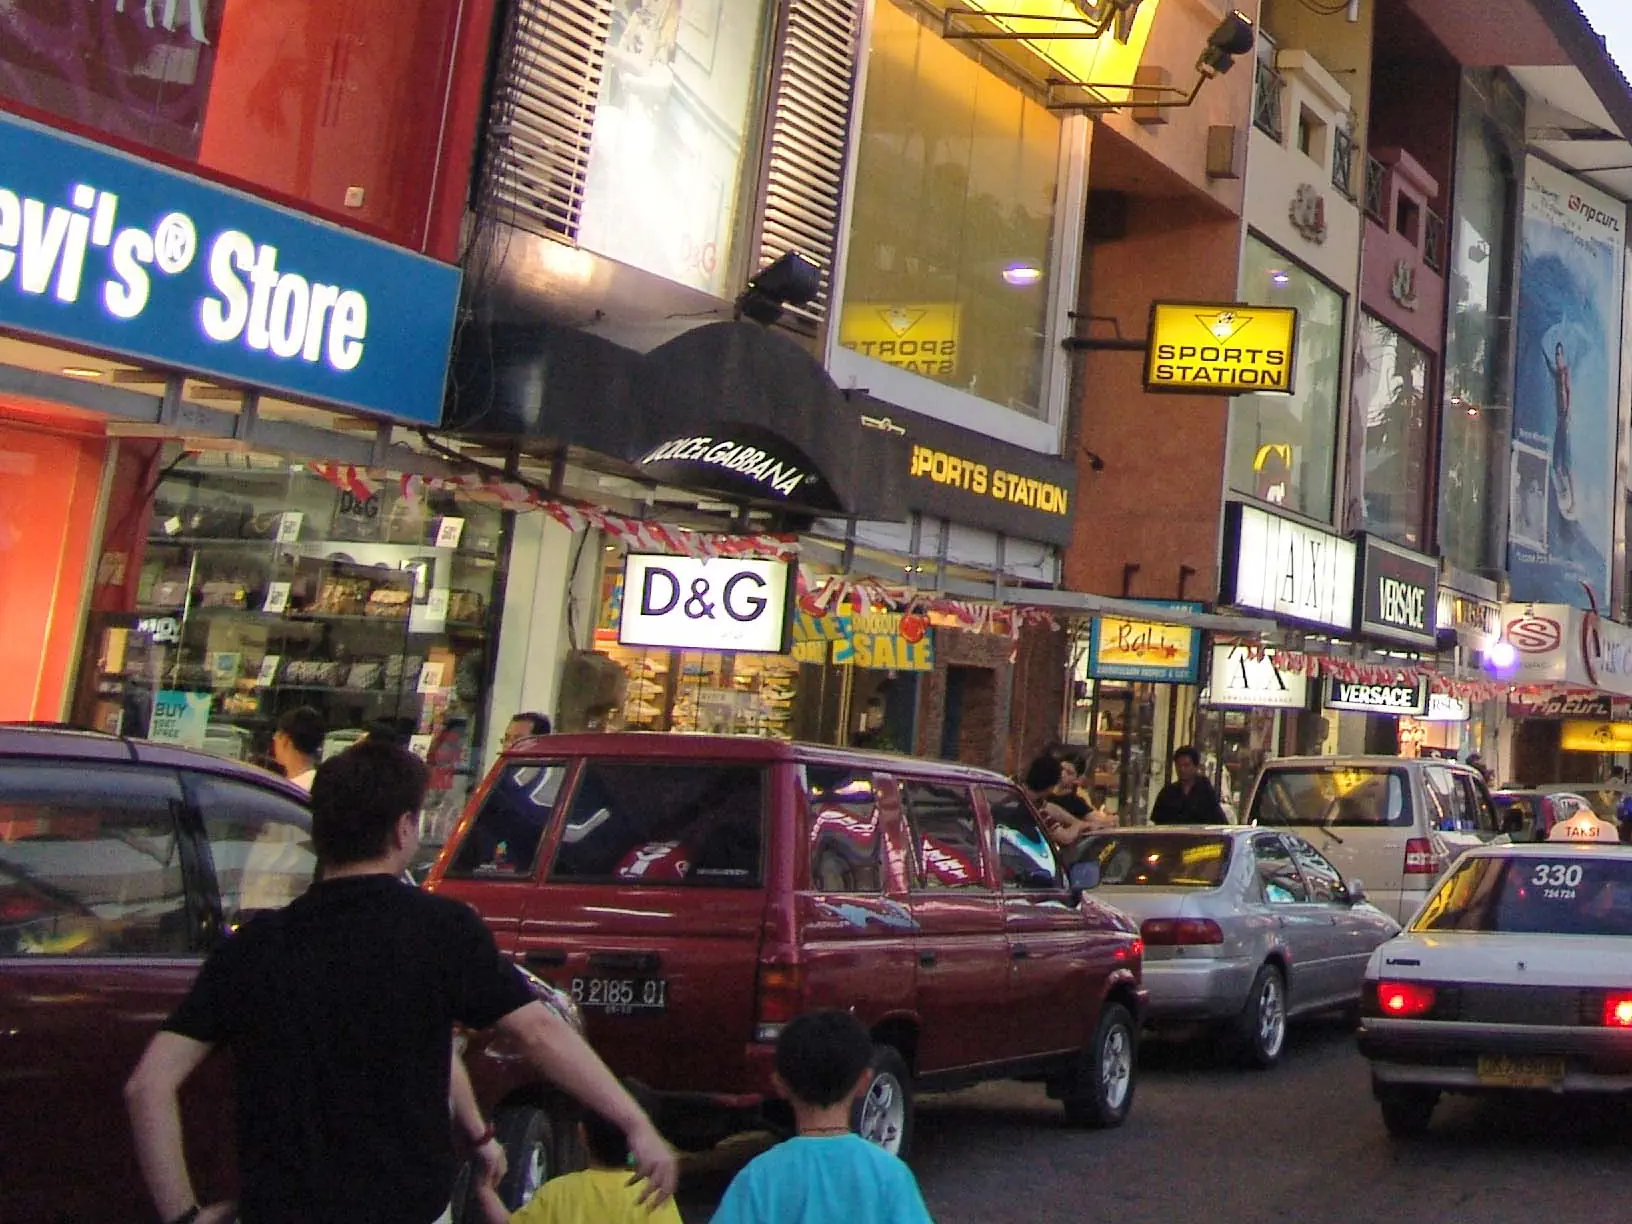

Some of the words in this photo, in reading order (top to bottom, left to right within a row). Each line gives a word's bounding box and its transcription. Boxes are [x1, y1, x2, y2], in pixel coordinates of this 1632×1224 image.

[202, 231, 369, 372] Store
[1157, 344, 1284, 366] SPORTS
[1155, 365, 1282, 386] STATION
[992, 469, 1068, 515] STATION
[639, 566, 768, 623] D&G
[1379, 575, 1426, 630] VERSACE
[1339, 683, 1414, 708] VERSACE
[155, 702, 186, 718] BUY
[1563, 825, 1601, 839] TAKSI
[1531, 864, 1583, 887] 330
[587, 978, 634, 1004] 2185
